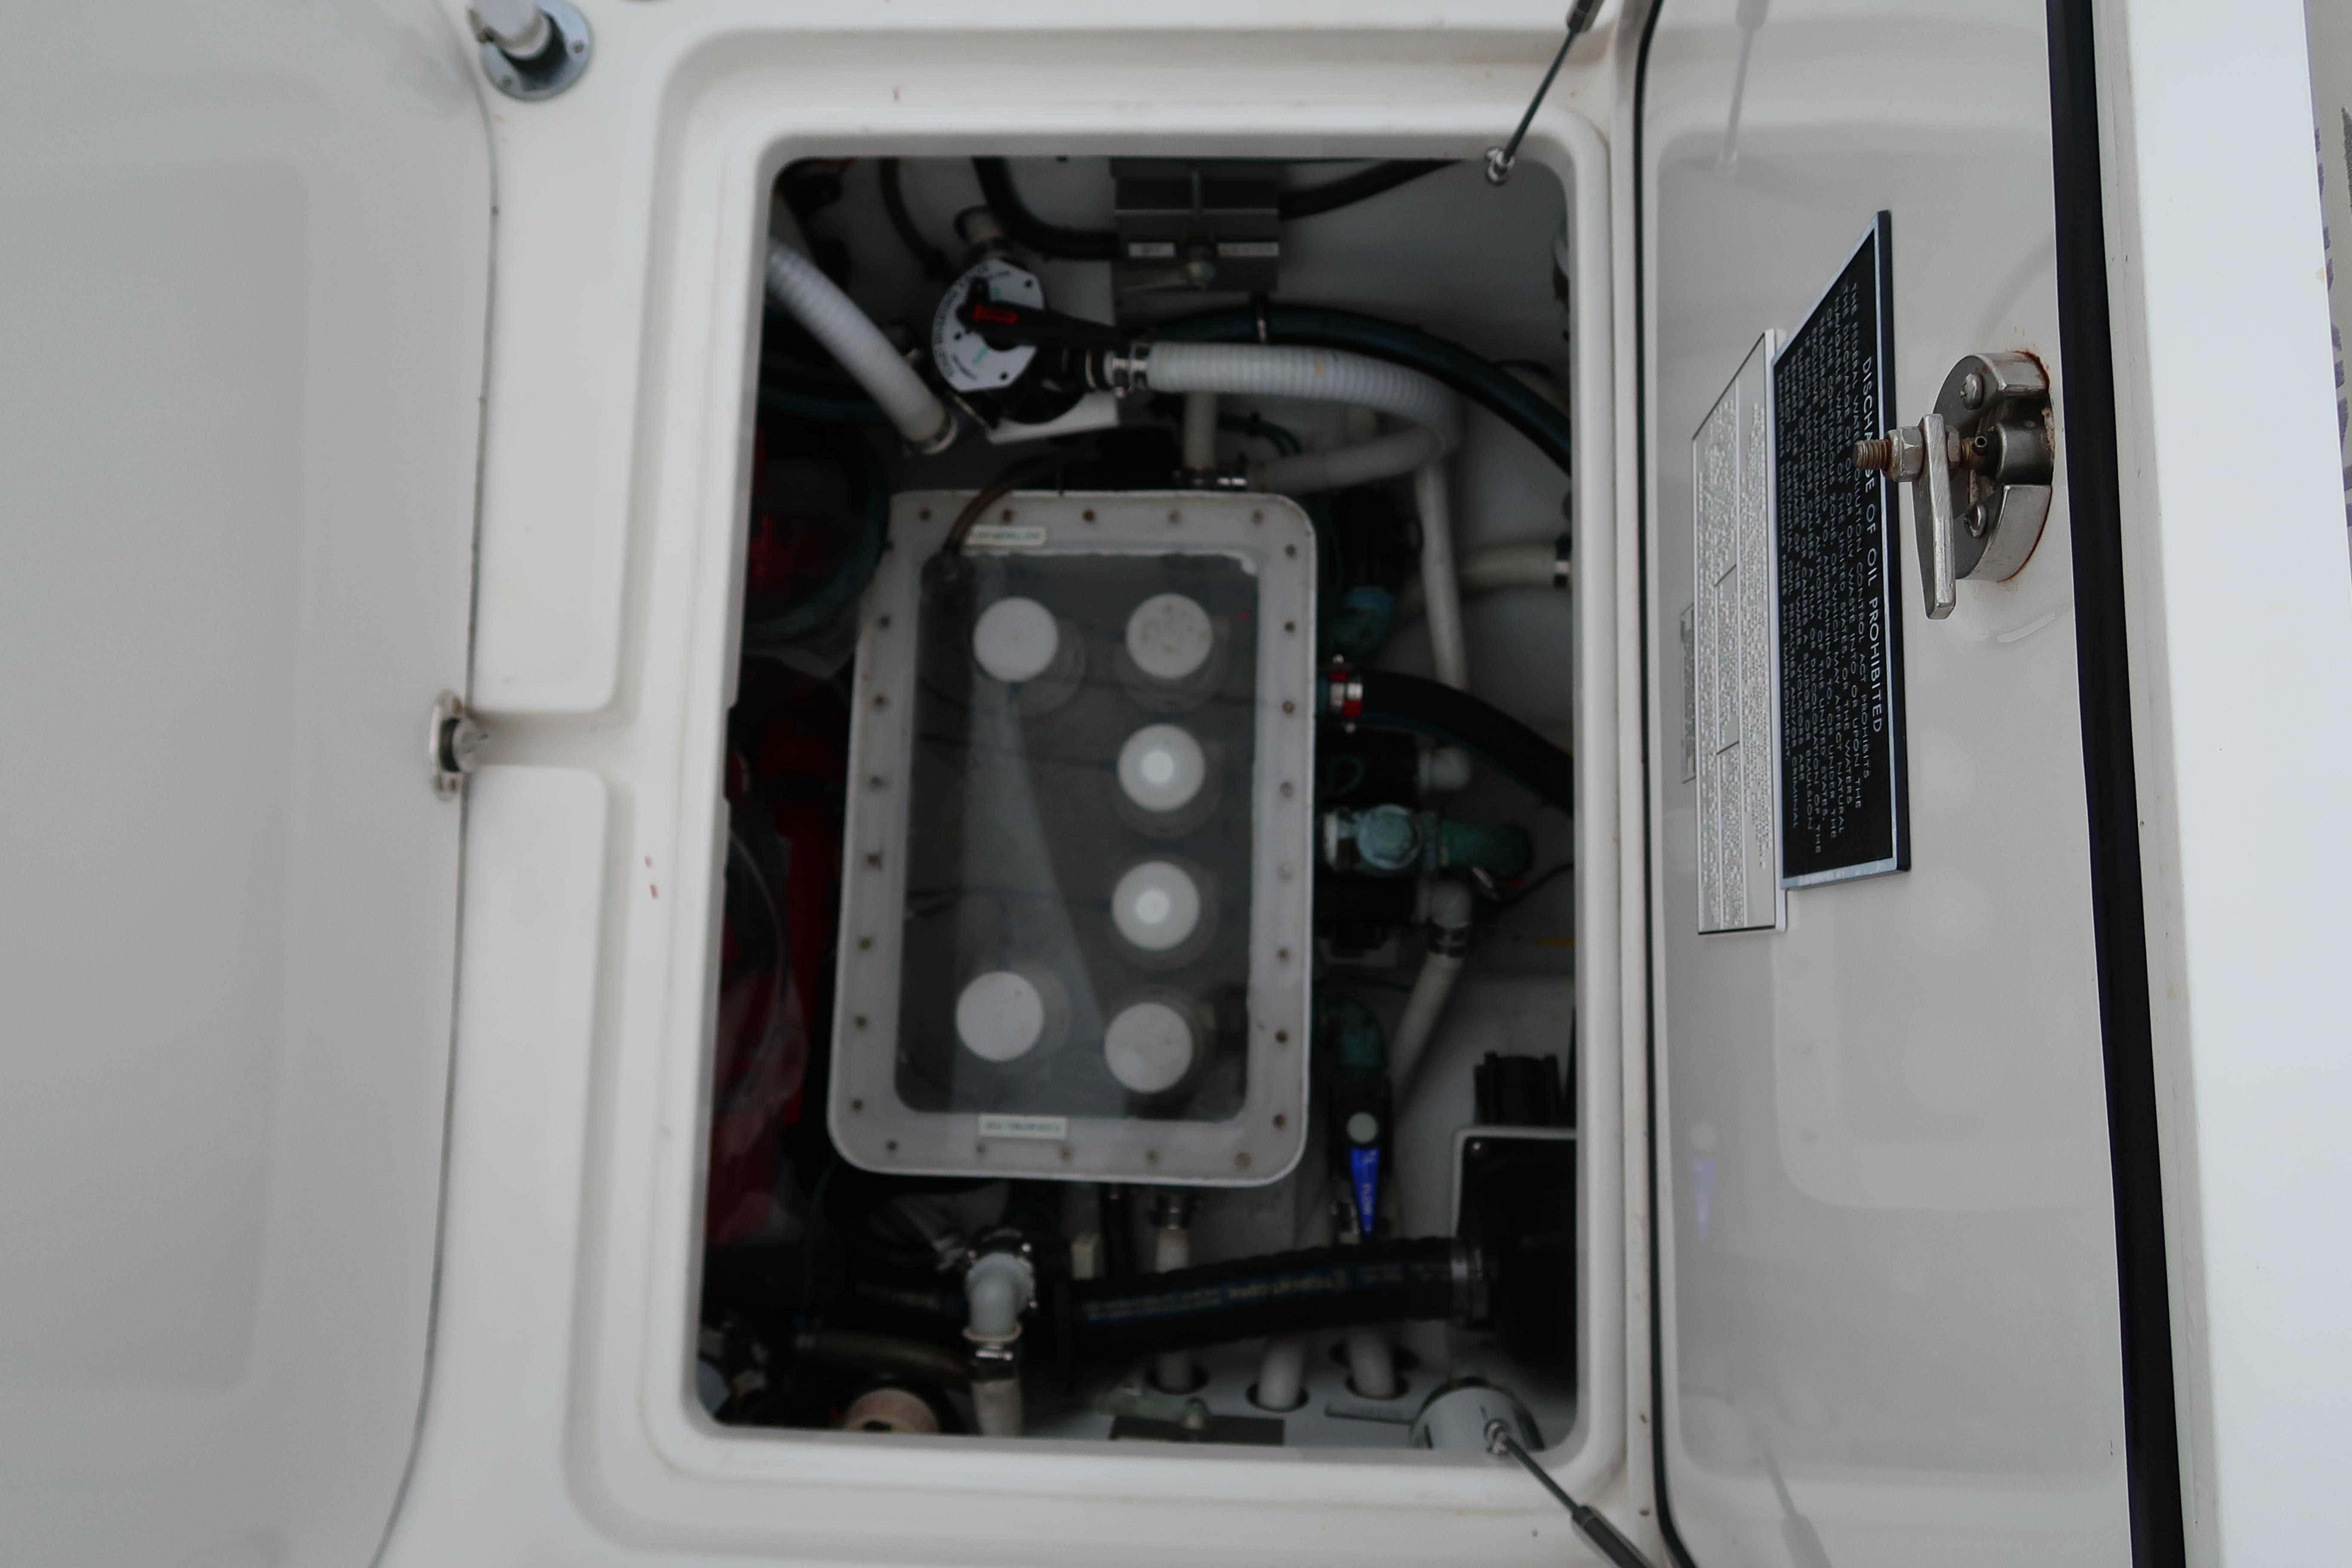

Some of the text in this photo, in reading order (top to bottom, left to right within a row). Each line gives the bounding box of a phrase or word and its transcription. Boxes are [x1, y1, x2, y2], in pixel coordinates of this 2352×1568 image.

[1826, 308, 1833, 328] OF
[1827, 375, 1835, 485] CONTIGUOUS
[1844, 426, 1851, 447] OF
[1846, 492, 1853, 516] OR
[1862, 357, 1882, 732] DISCHAGE OF OIL PROHIBITED
[1831, 553, 1837, 576] OR
[1837, 462, 1844, 484] OF
[1842, 667, 1848, 690] OR
[1856, 562, 1865, 643] CONTROL
[1861, 694, 1870, 778] PROHIBITS
[1851, 685, 1858, 708] OR
